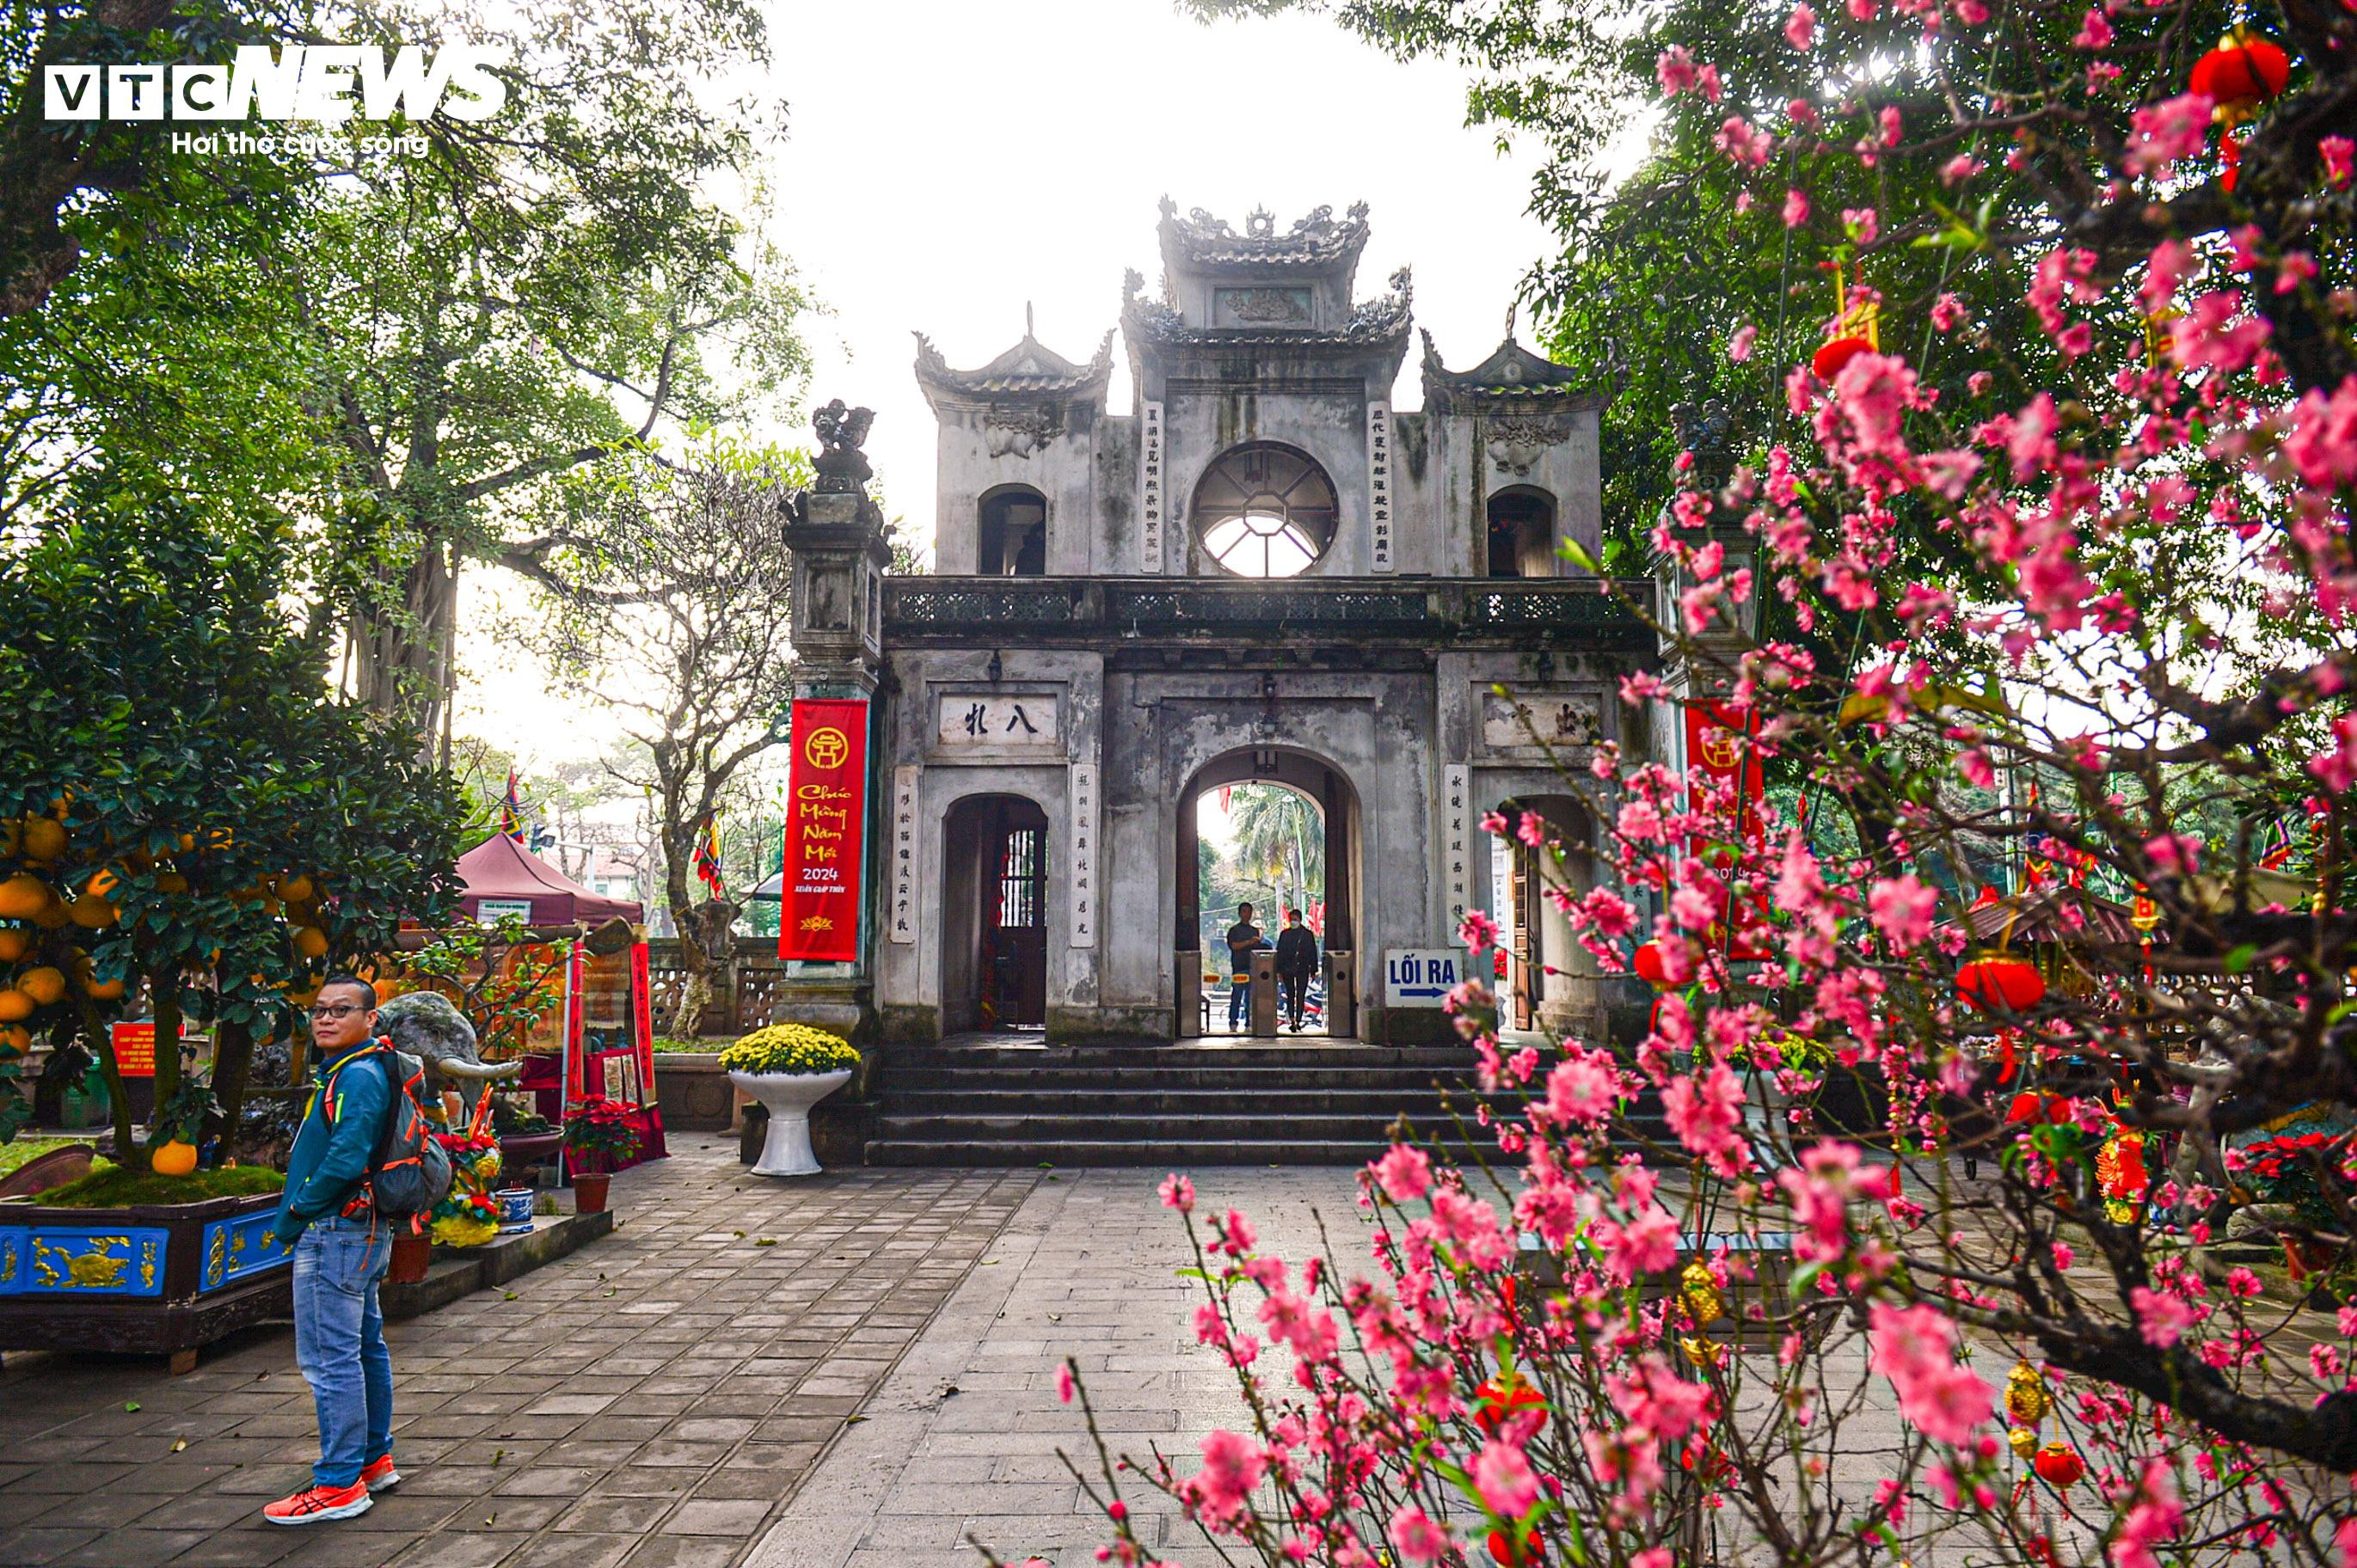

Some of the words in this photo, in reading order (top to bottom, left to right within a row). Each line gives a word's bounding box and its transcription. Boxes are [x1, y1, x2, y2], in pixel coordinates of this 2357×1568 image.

[796, 783, 854, 800] Chúc
[799, 802, 849, 830] Mừng
[802, 824, 843, 841] Năm
[804, 843, 838, 862] Mới
[801, 867, 839, 881] 2024
[1389, 952, 1421, 984] LỐI
[1427, 959, 1456, 984] RA
